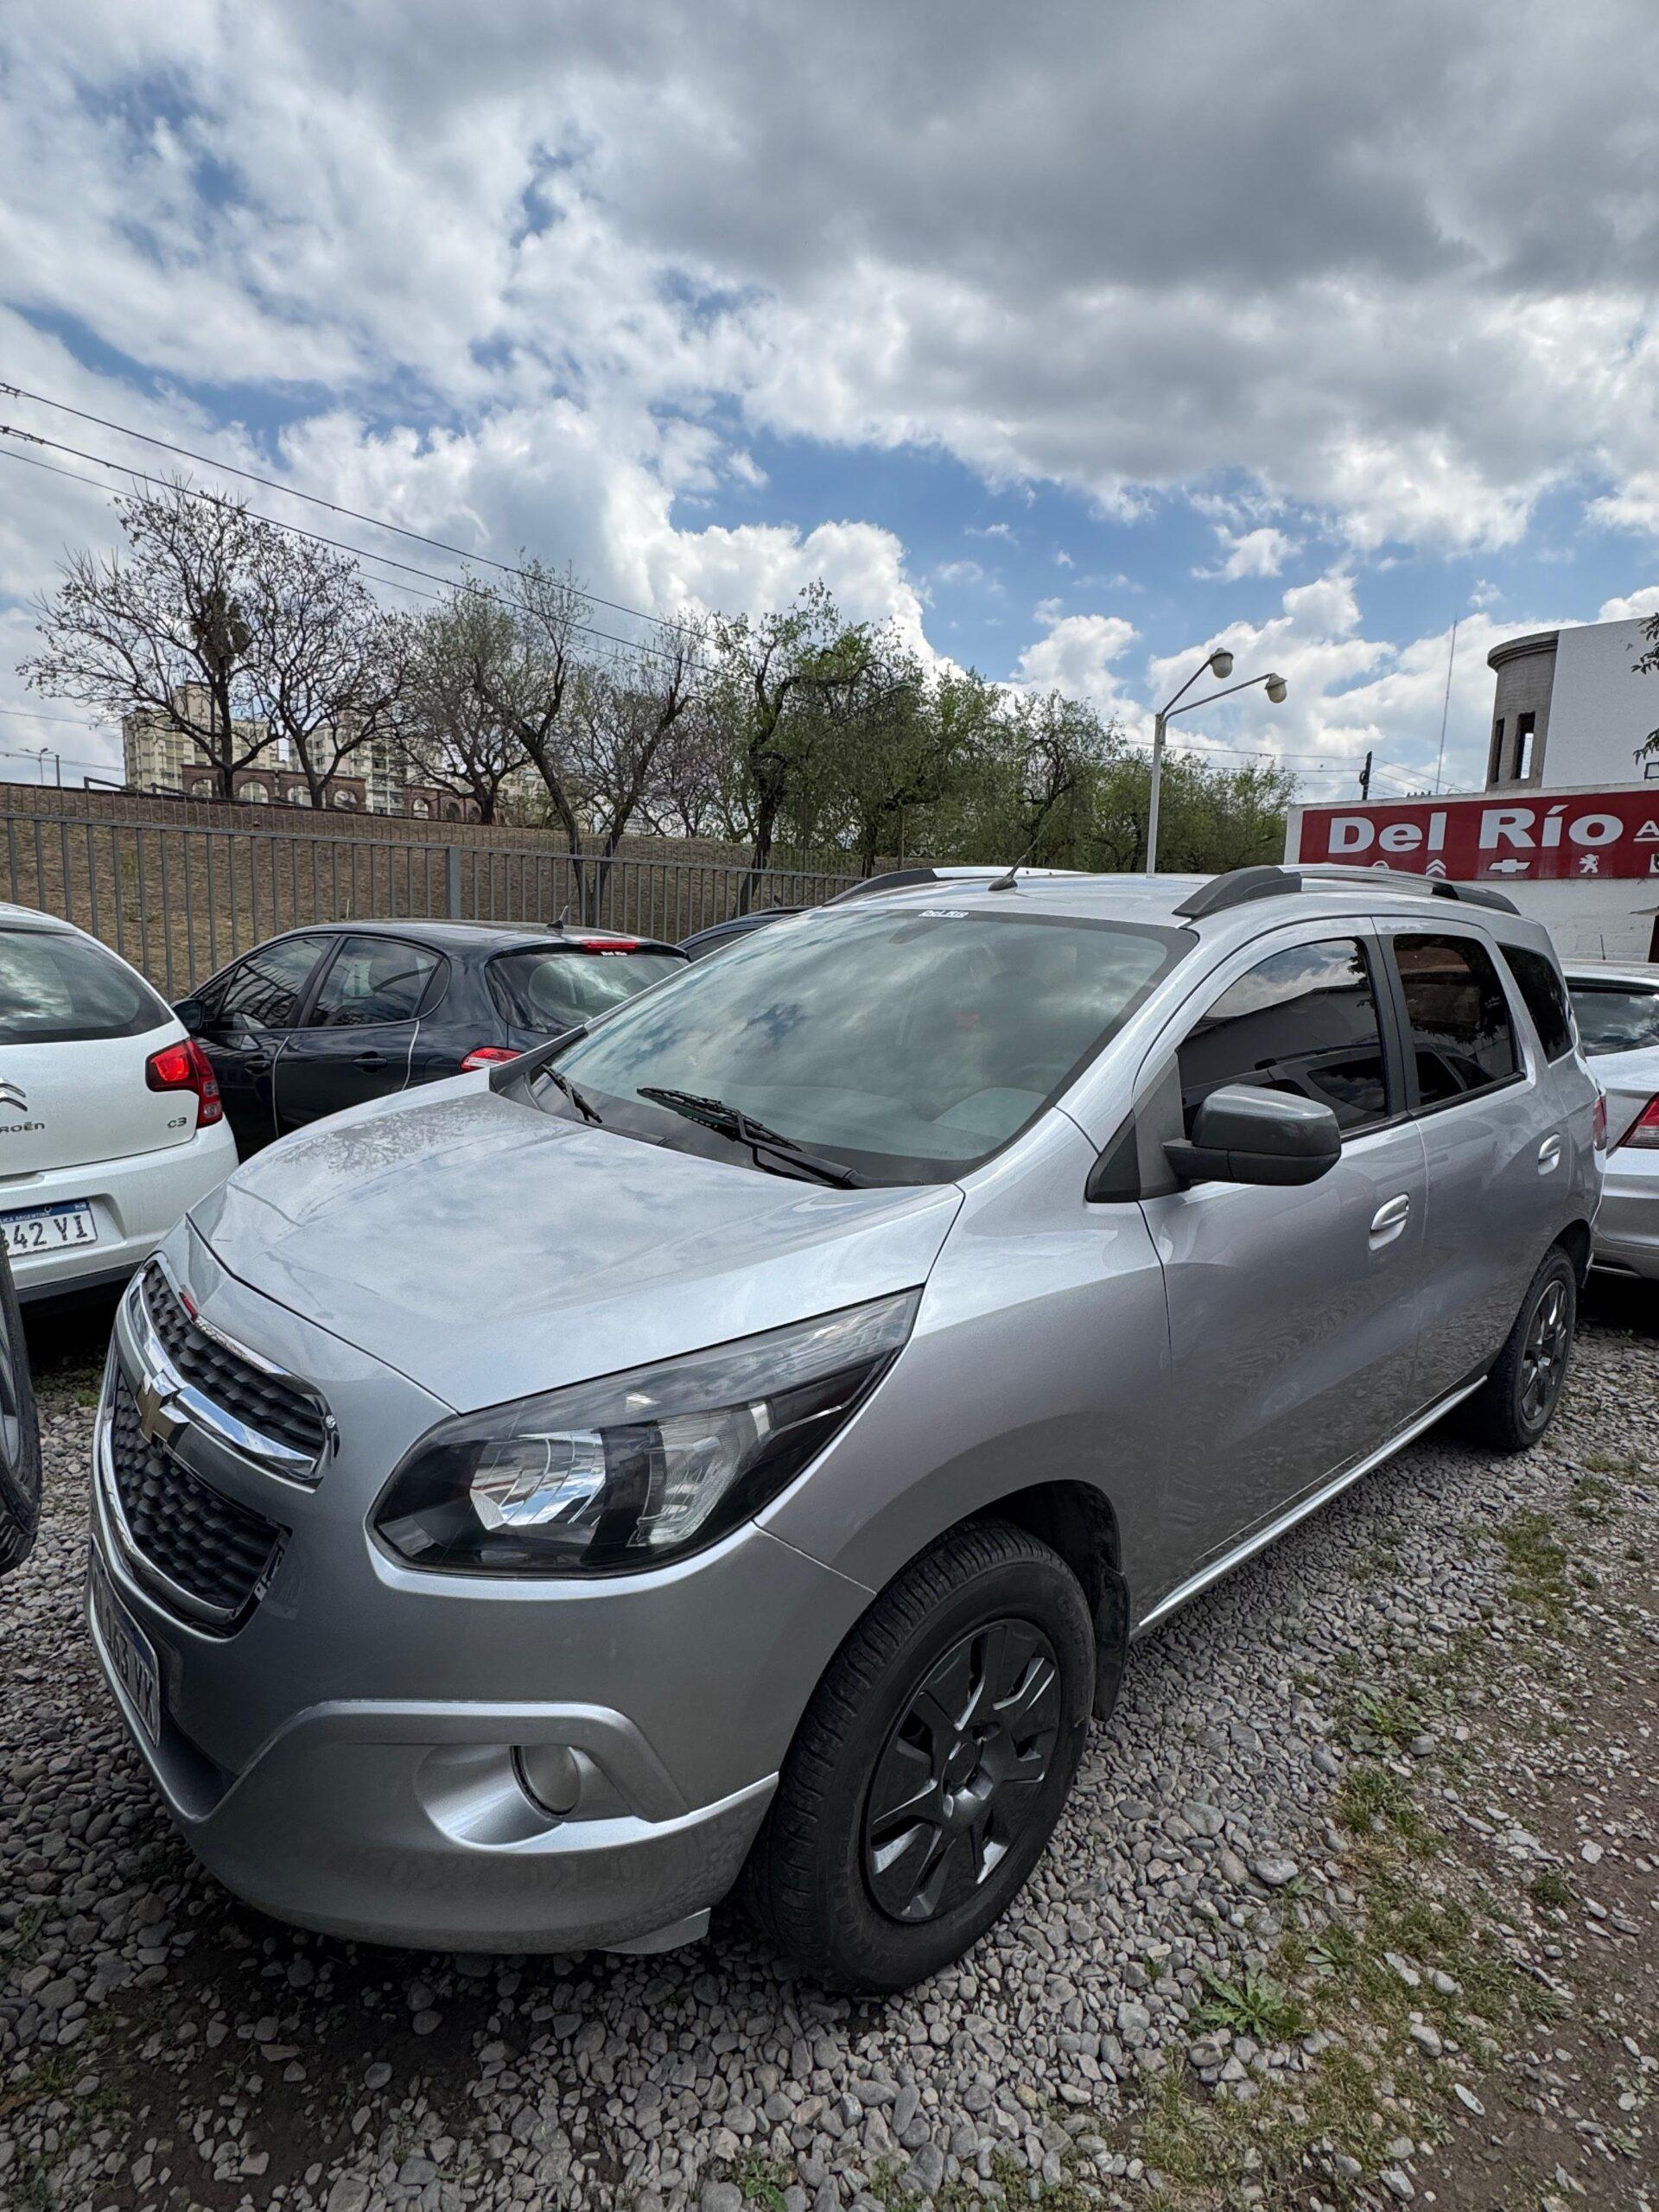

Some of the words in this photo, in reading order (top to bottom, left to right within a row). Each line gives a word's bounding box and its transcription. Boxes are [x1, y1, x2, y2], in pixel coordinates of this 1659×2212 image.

[1328, 811, 1447, 854] Del
[1478, 804, 1624, 849] Río
[167, 1116, 187, 1128] C3
